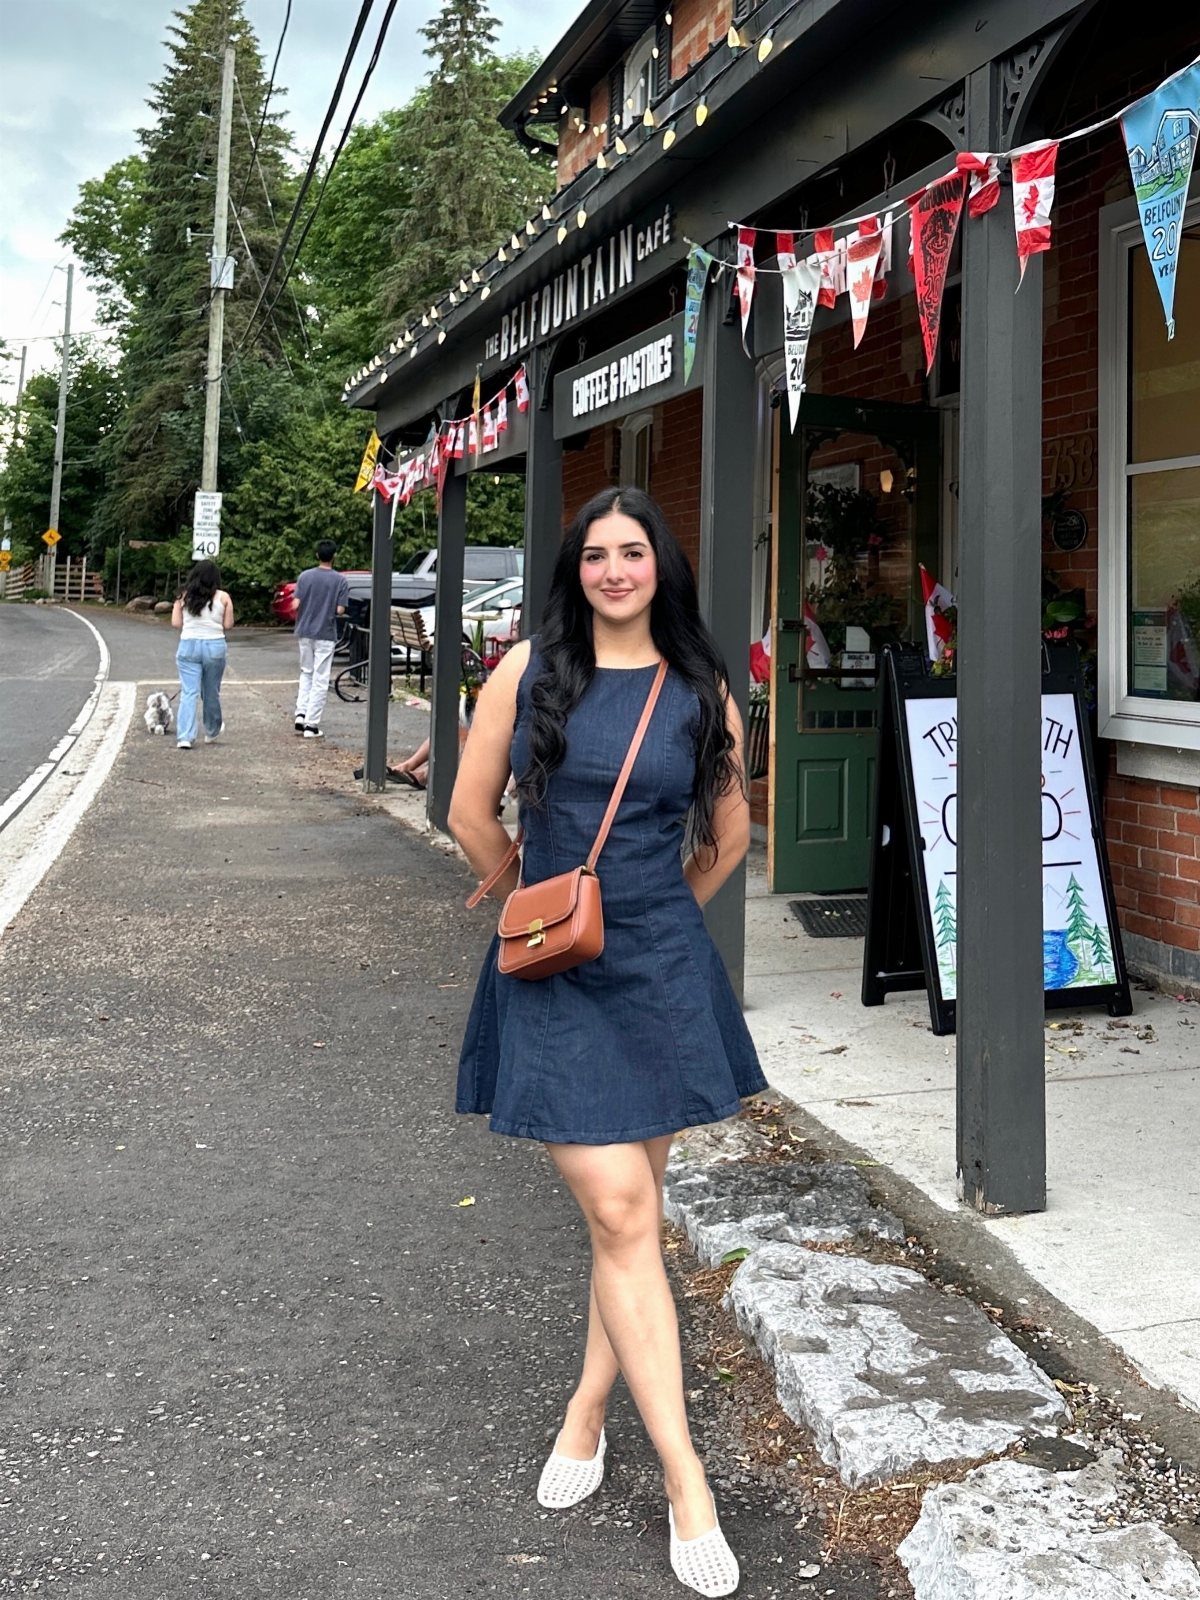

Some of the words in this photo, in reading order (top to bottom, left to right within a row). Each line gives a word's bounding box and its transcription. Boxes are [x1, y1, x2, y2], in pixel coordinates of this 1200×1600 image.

[1152, 221, 1177, 261] 20
[485, 333, 499, 359] THE
[500, 224, 633, 361] BELFOUNTAIN
[637, 204, 671, 261] CAFÉ
[573, 366, 609, 417] COFFEE
[610, 361, 619, 402] &
[620, 334, 673, 398] PASTRIES
[196, 541, 217, 555] 40
[922, 716, 958, 758] TR
